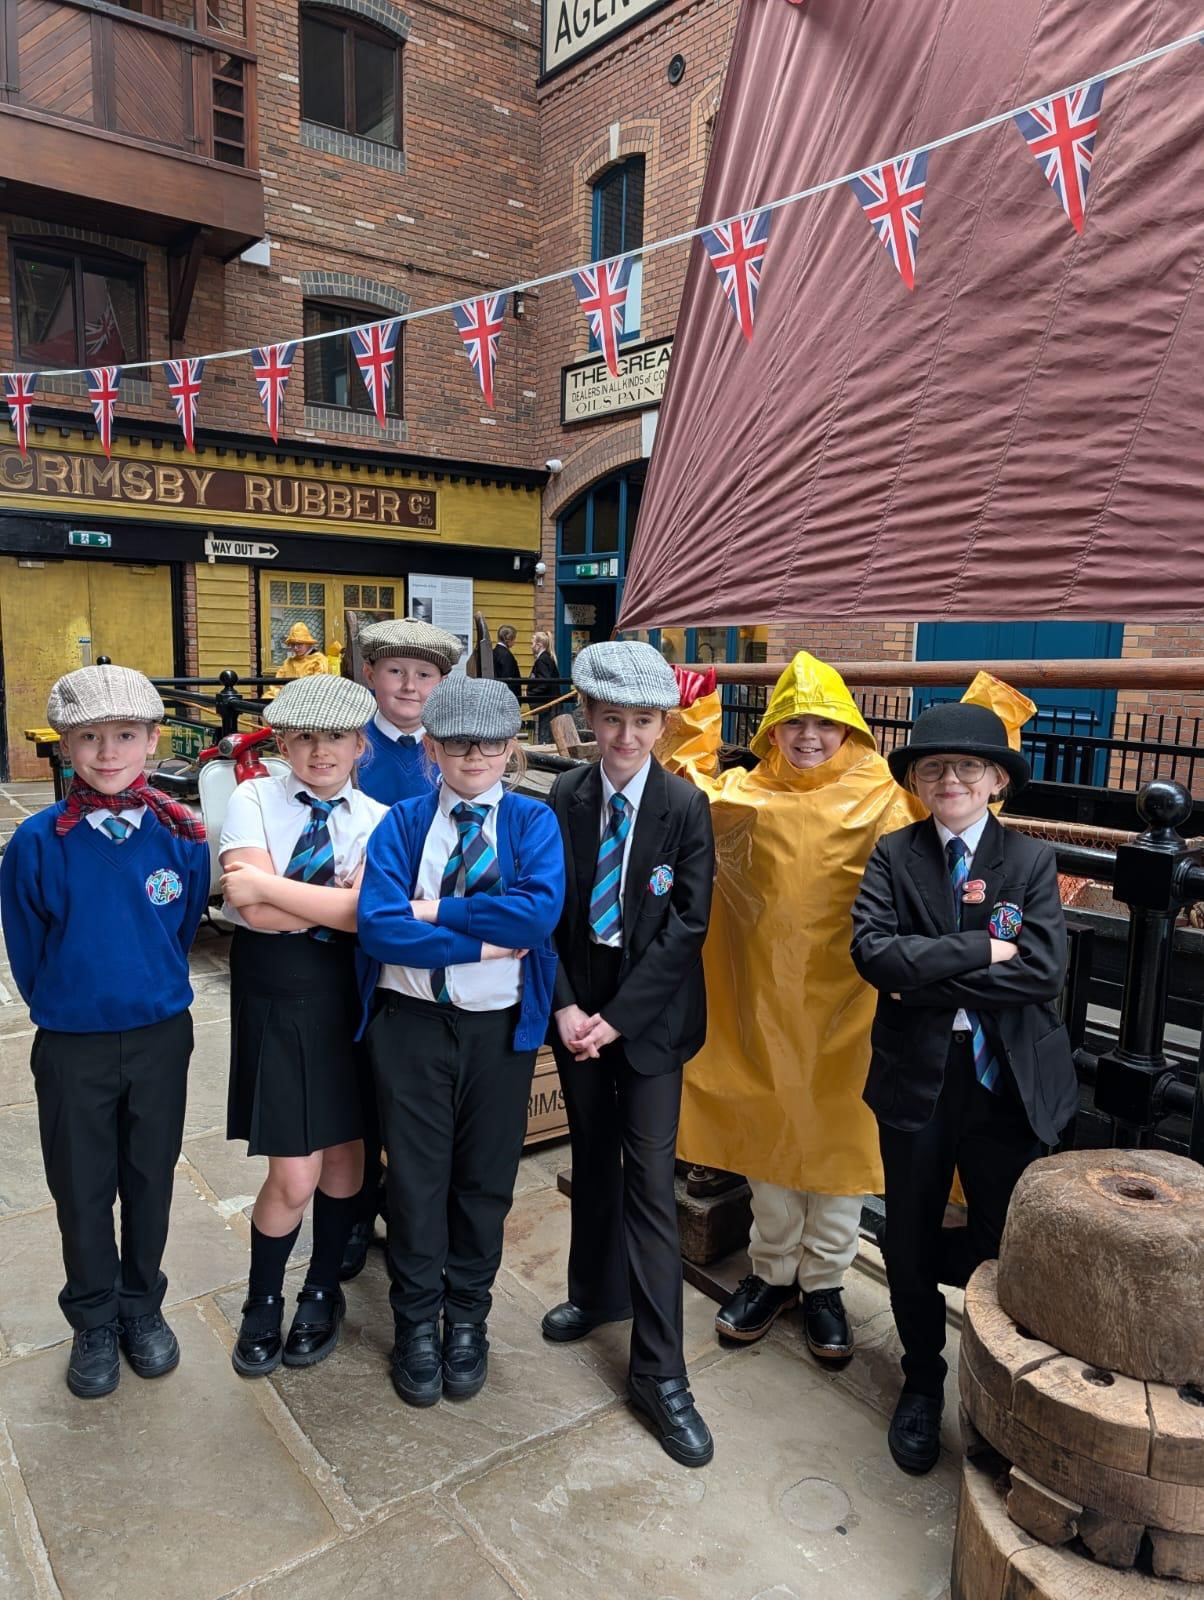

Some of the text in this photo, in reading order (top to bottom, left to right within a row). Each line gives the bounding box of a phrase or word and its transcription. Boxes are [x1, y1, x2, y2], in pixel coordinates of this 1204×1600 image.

[571, 346, 672, 388] THE GREA
[571, 386, 601, 403] DEALERS
[601, 385, 609, 395] IN
[609, 380, 621, 392] ALL
[622, 375, 644, 389] KINDS
[644, 373, 651, 384] of
[575, 396, 612, 415] OILS
[0, 450, 216, 506] GRIMSBY
[244, 474, 401, 523] RUBBER
[211, 541, 254, 556] WAY OUT
